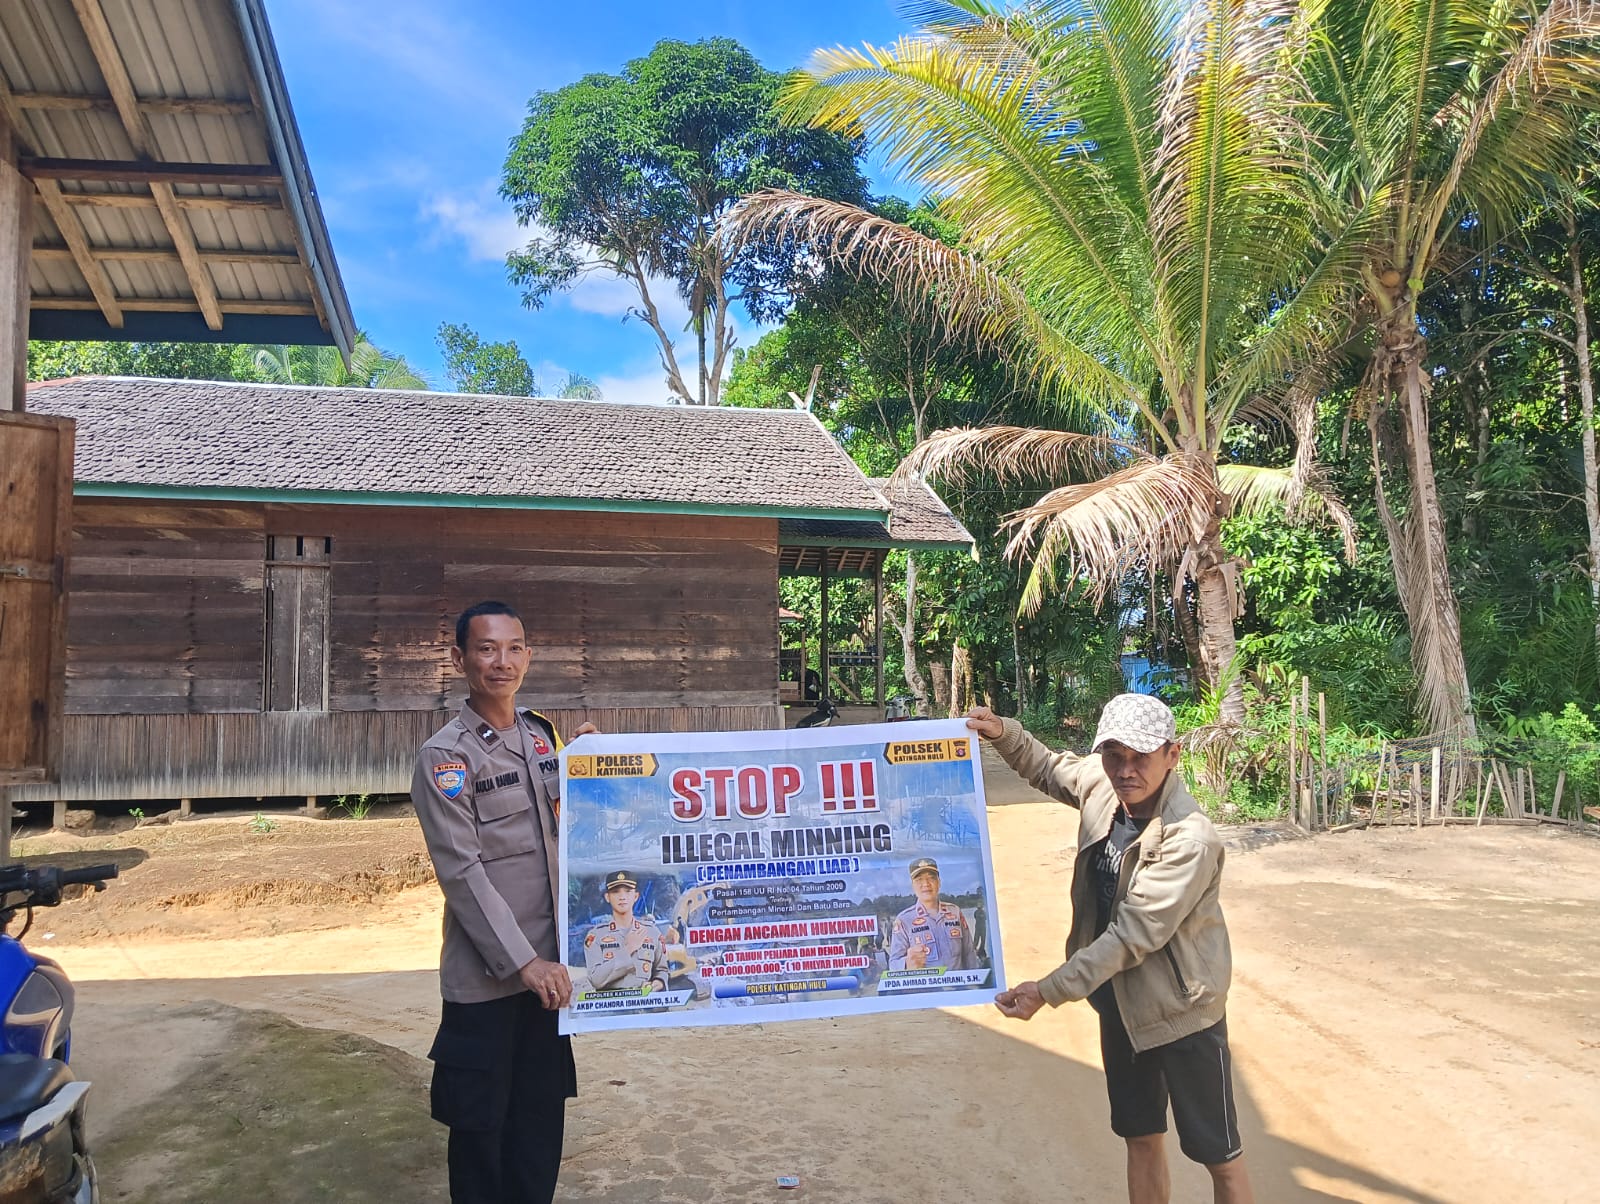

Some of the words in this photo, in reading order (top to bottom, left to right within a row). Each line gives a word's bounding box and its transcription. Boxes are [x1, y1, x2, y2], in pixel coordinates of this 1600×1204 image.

[893, 742, 943, 755] POLSEK
[596, 755, 643, 767] POLRES
[894, 754, 926, 763] KATINGAN
[926, 752, 944, 761] HULU
[596, 767, 644, 777] KATINGAN
[671, 765, 802, 820] STOP
[820, 761, 876, 811] !!!
[662, 831, 766, 865] ILLEGAL
[770, 824, 892, 858] MINNING
[706, 860, 816, 881] PENAMBANGAN
[819, 859, 851, 875] LIAR
[716, 889, 737, 897] Pasal
[739, 888, 751, 896] 158
[753, 887, 765, 895] UU
[801, 884, 825, 892] Tahun
[711, 907, 766, 917] Pertambangan
[767, 904, 795, 913] Mineral
[797, 902, 811, 911] Dan
[813, 901, 831, 910] Batu
[832, 901, 851, 909] Bara
[689, 927, 741, 945] DENGAN
[743, 923, 808, 941] ANCAMAN
[810, 918, 876, 937] HUKUMAN
[724, 952, 734, 963] 10
[735, 950, 763, 962] TAHUN
[763, 948, 799, 961] PENJARA
[799, 947, 816, 958] DAN
[817, 945, 845, 957] DENDA
[701, 967, 713, 978] RP.
[802, 959, 831, 971] MILYAR
[832, 957, 862, 969] RUPIAH
[746, 983, 772, 994] POLSEK
[774, 981, 808, 993] KATINGAN
[809, 979, 827, 990] HULU
[884, 979, 901, 988] IPDA
[902, 978, 927, 987] AHMAD
[928, 976, 966, 986] SACHRANI,
[576, 1002, 594, 1011] AKBP
[595, 1000, 624, 1009] CHANDRA
